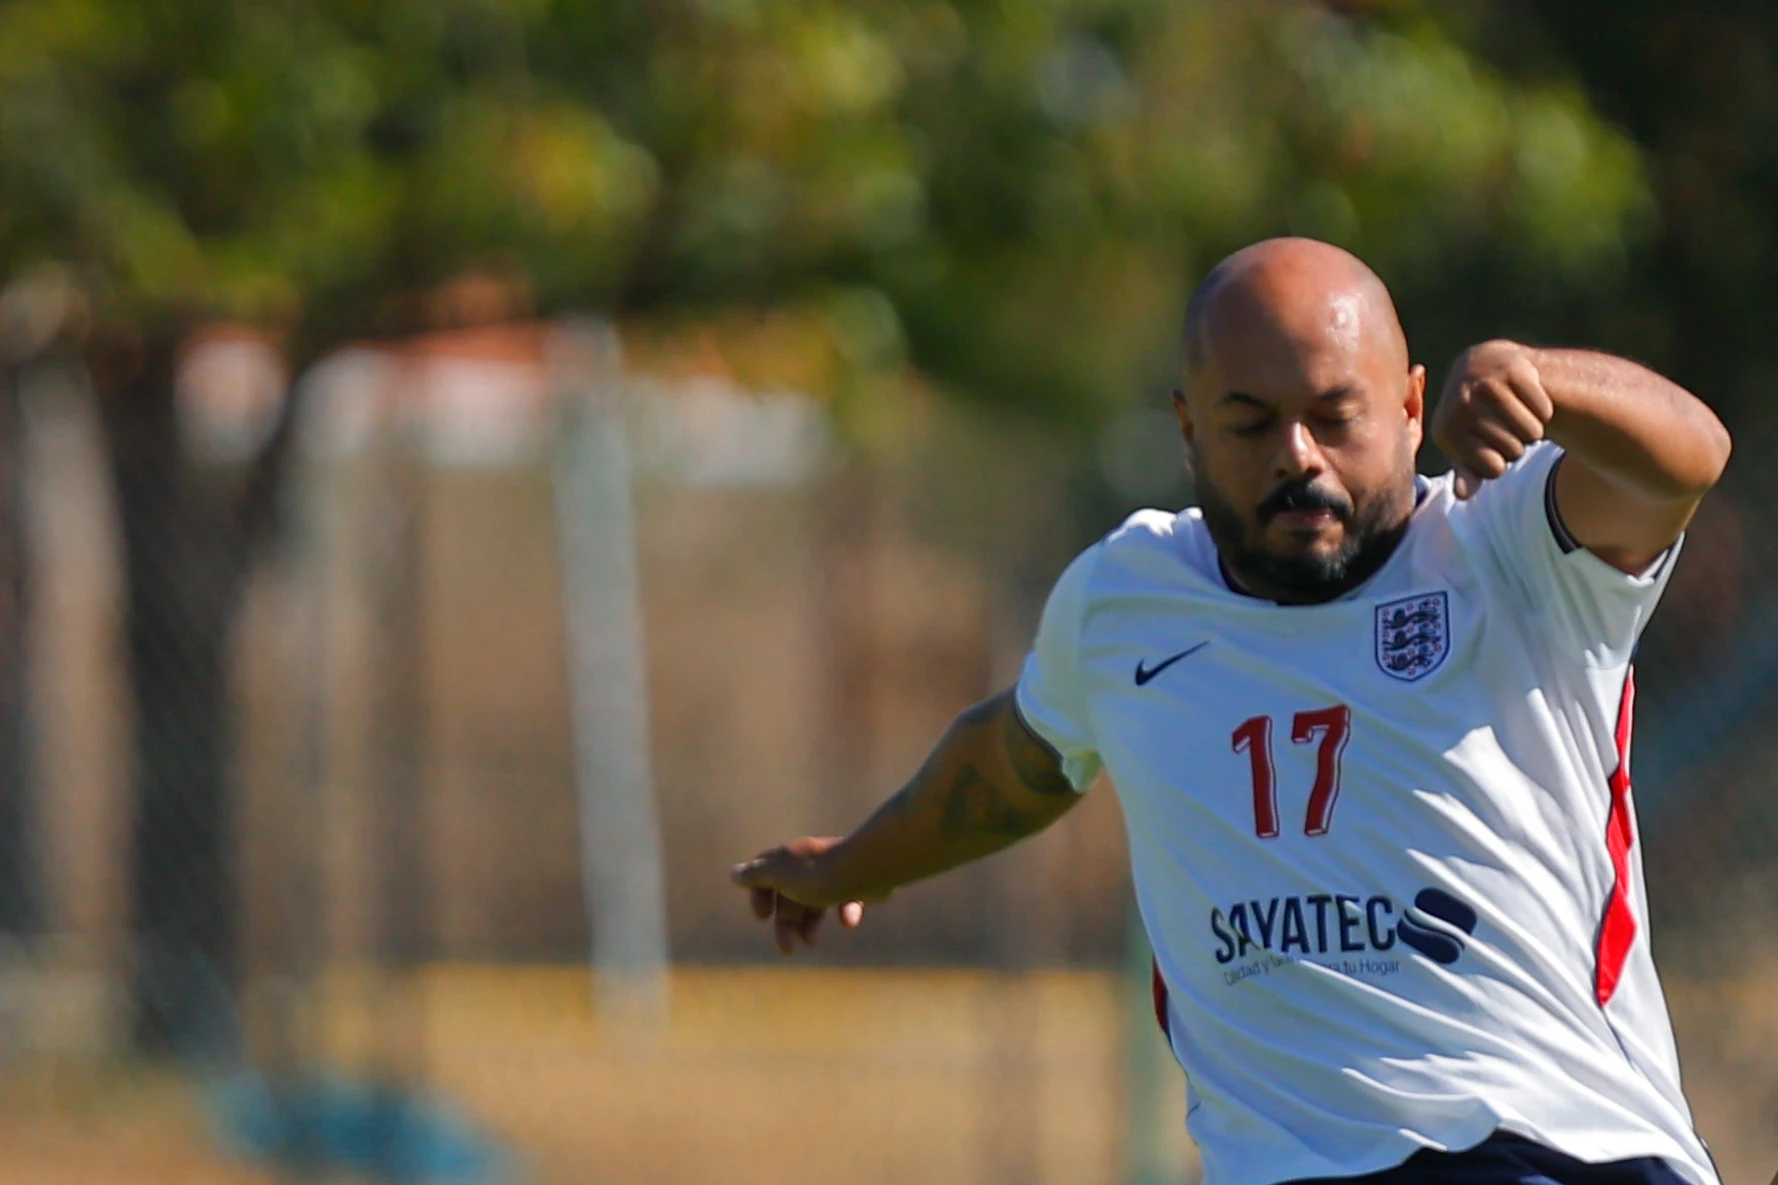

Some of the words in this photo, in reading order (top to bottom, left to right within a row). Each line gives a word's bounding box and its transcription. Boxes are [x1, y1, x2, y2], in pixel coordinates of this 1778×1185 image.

[1231, 703, 1352, 839] 17
[1210, 894, 1396, 964] SAYATEC
[1343, 960, 1357, 974] tu
[1360, 959, 1399, 976] Hogar
